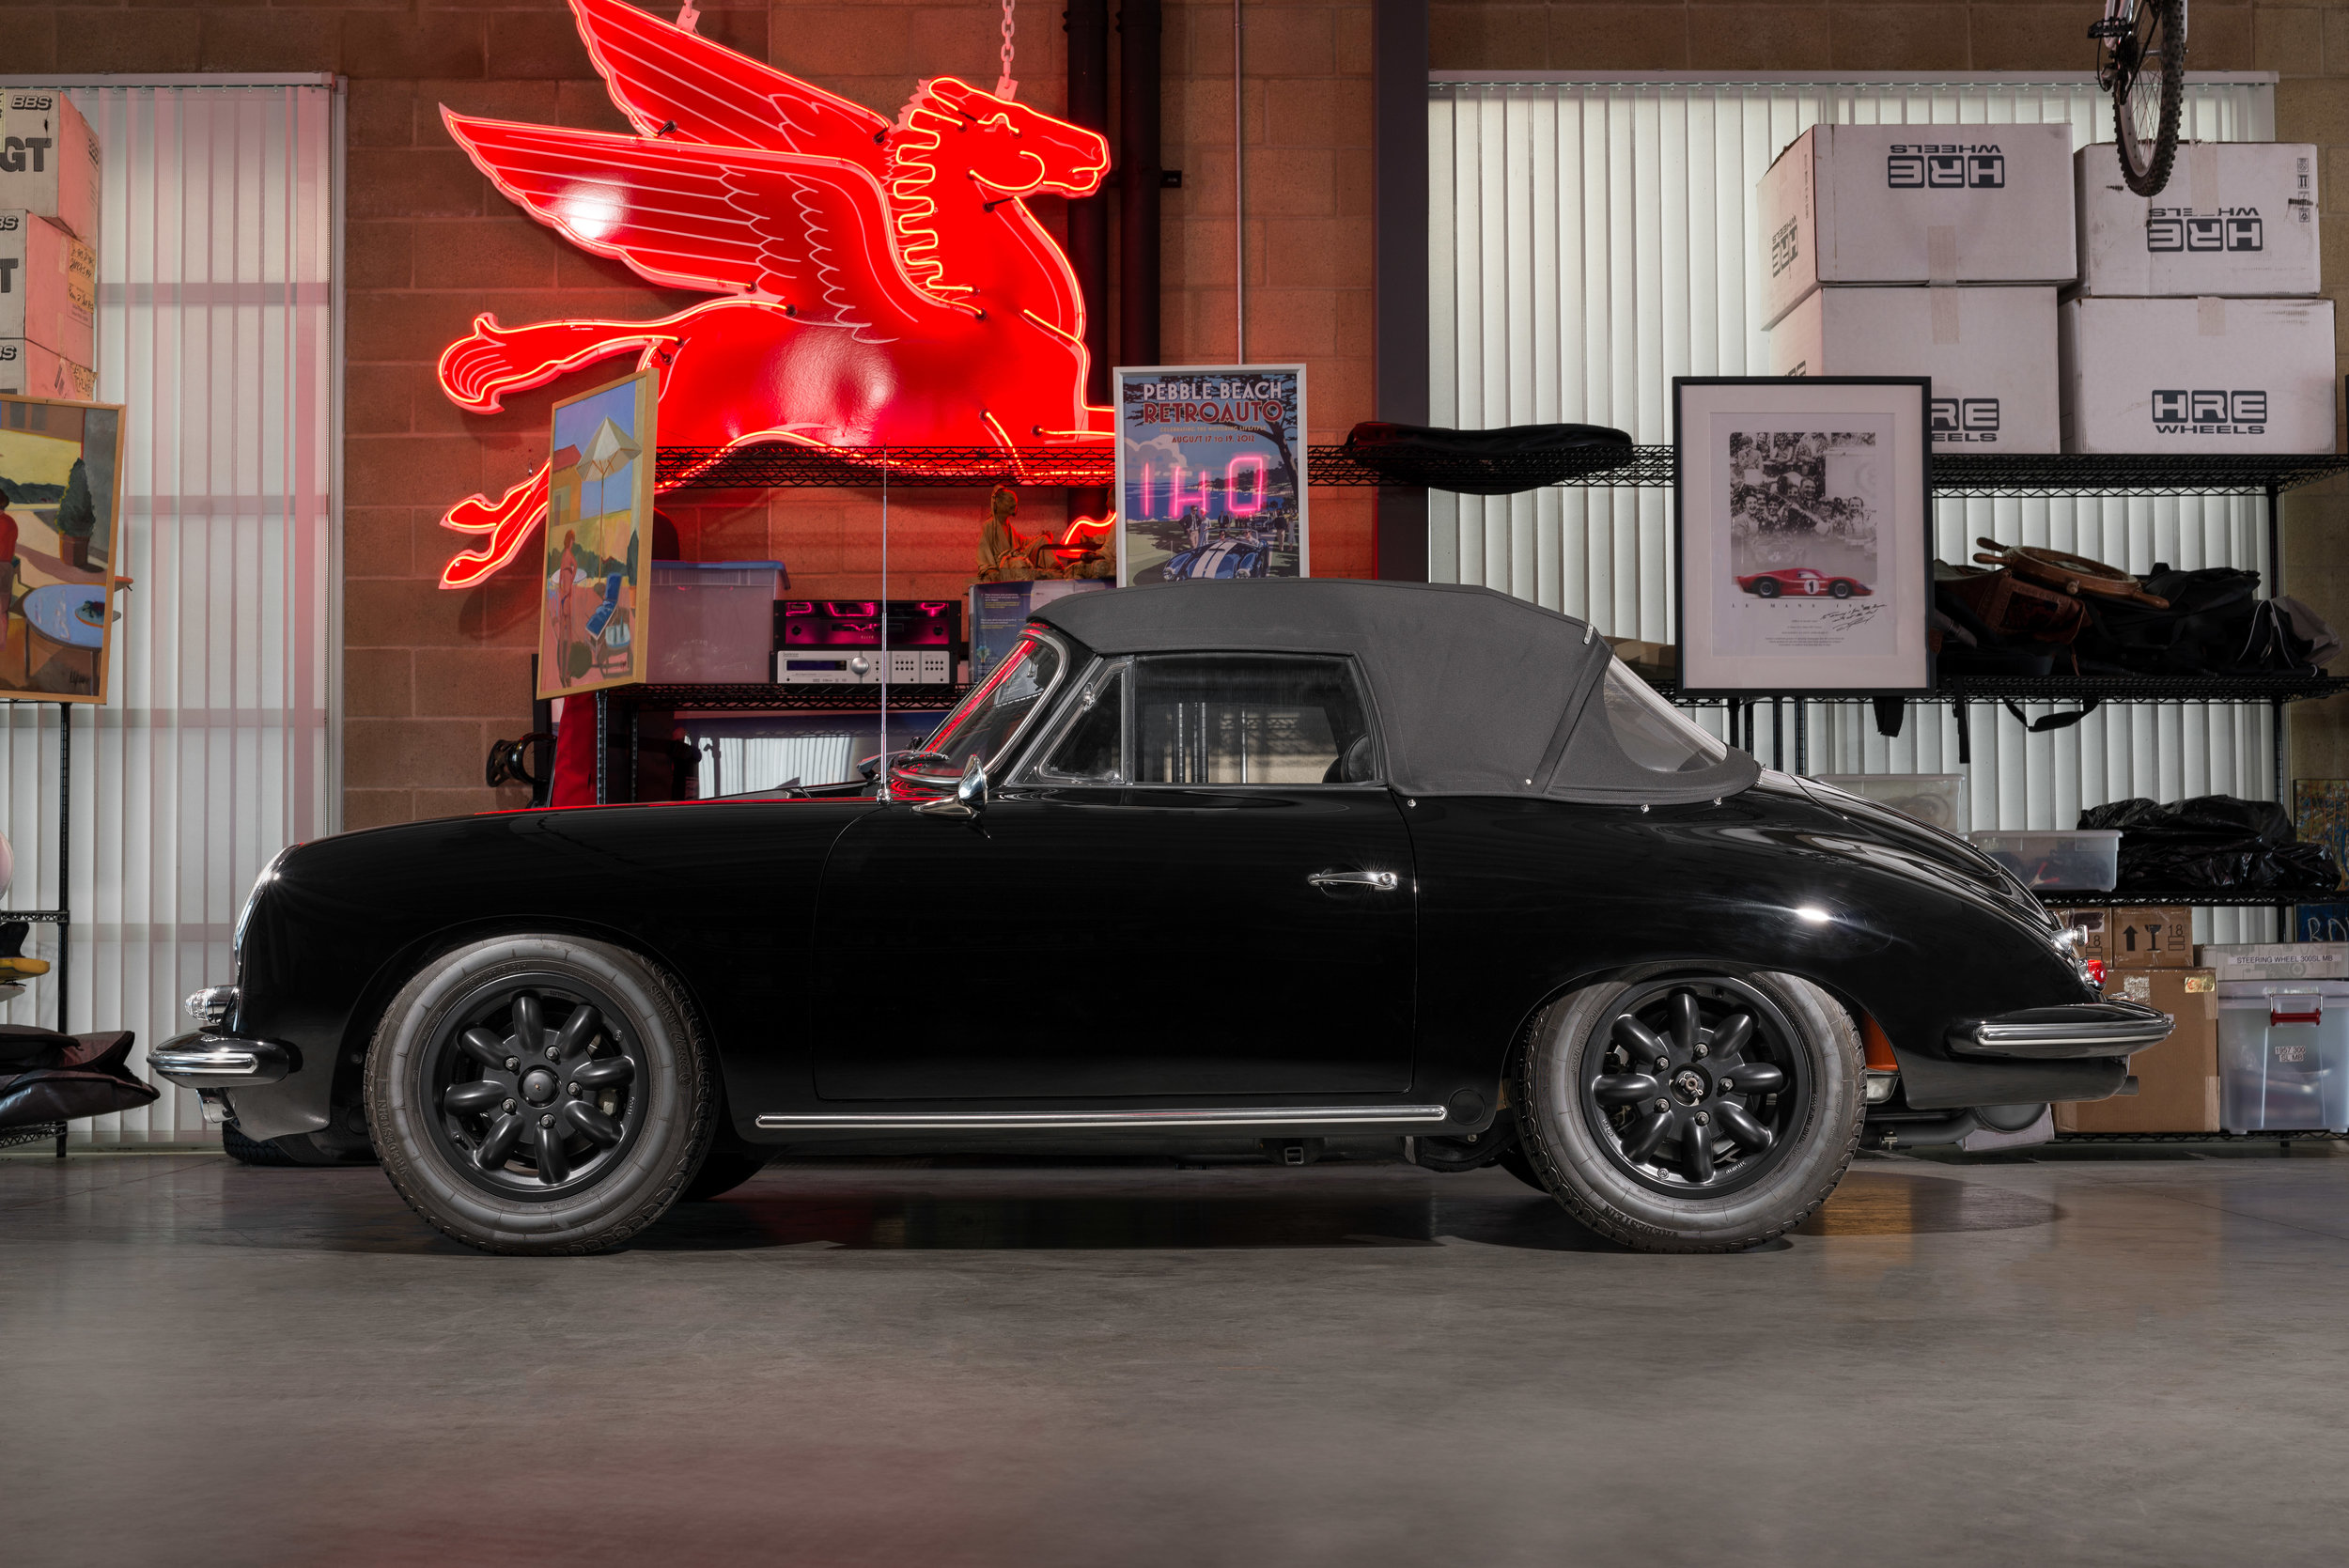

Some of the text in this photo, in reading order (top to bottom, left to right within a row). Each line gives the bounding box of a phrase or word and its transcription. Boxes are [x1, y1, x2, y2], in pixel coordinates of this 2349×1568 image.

[10, 95, 53, 111] BBS
[0, 136, 53, 173] GT
[1889, 144, 2002, 154] WHEELS
[1887, 155, 2005, 188] HRE
[2148, 208, 2260, 217] WHELS
[2147, 218, 2263, 252] HRE
[1771, 224, 1799, 279] HRE
[1143, 381, 1283, 401] PEBBLE BEACH
[1143, 400, 1283, 424] RETROAUTO
[1931, 398, 1999, 431] RE
[2152, 390, 2267, 424] HRE
[1237, 434, 1255, 442] 2012
[1931, 432, 1998, 442] EELS
[2155, 425, 2265, 435] WHEELS
[2167, 924, 2184, 937] 18
[2236, 955, 2272, 964] STEERING
[648, 984, 678, 1027] SPRINT
